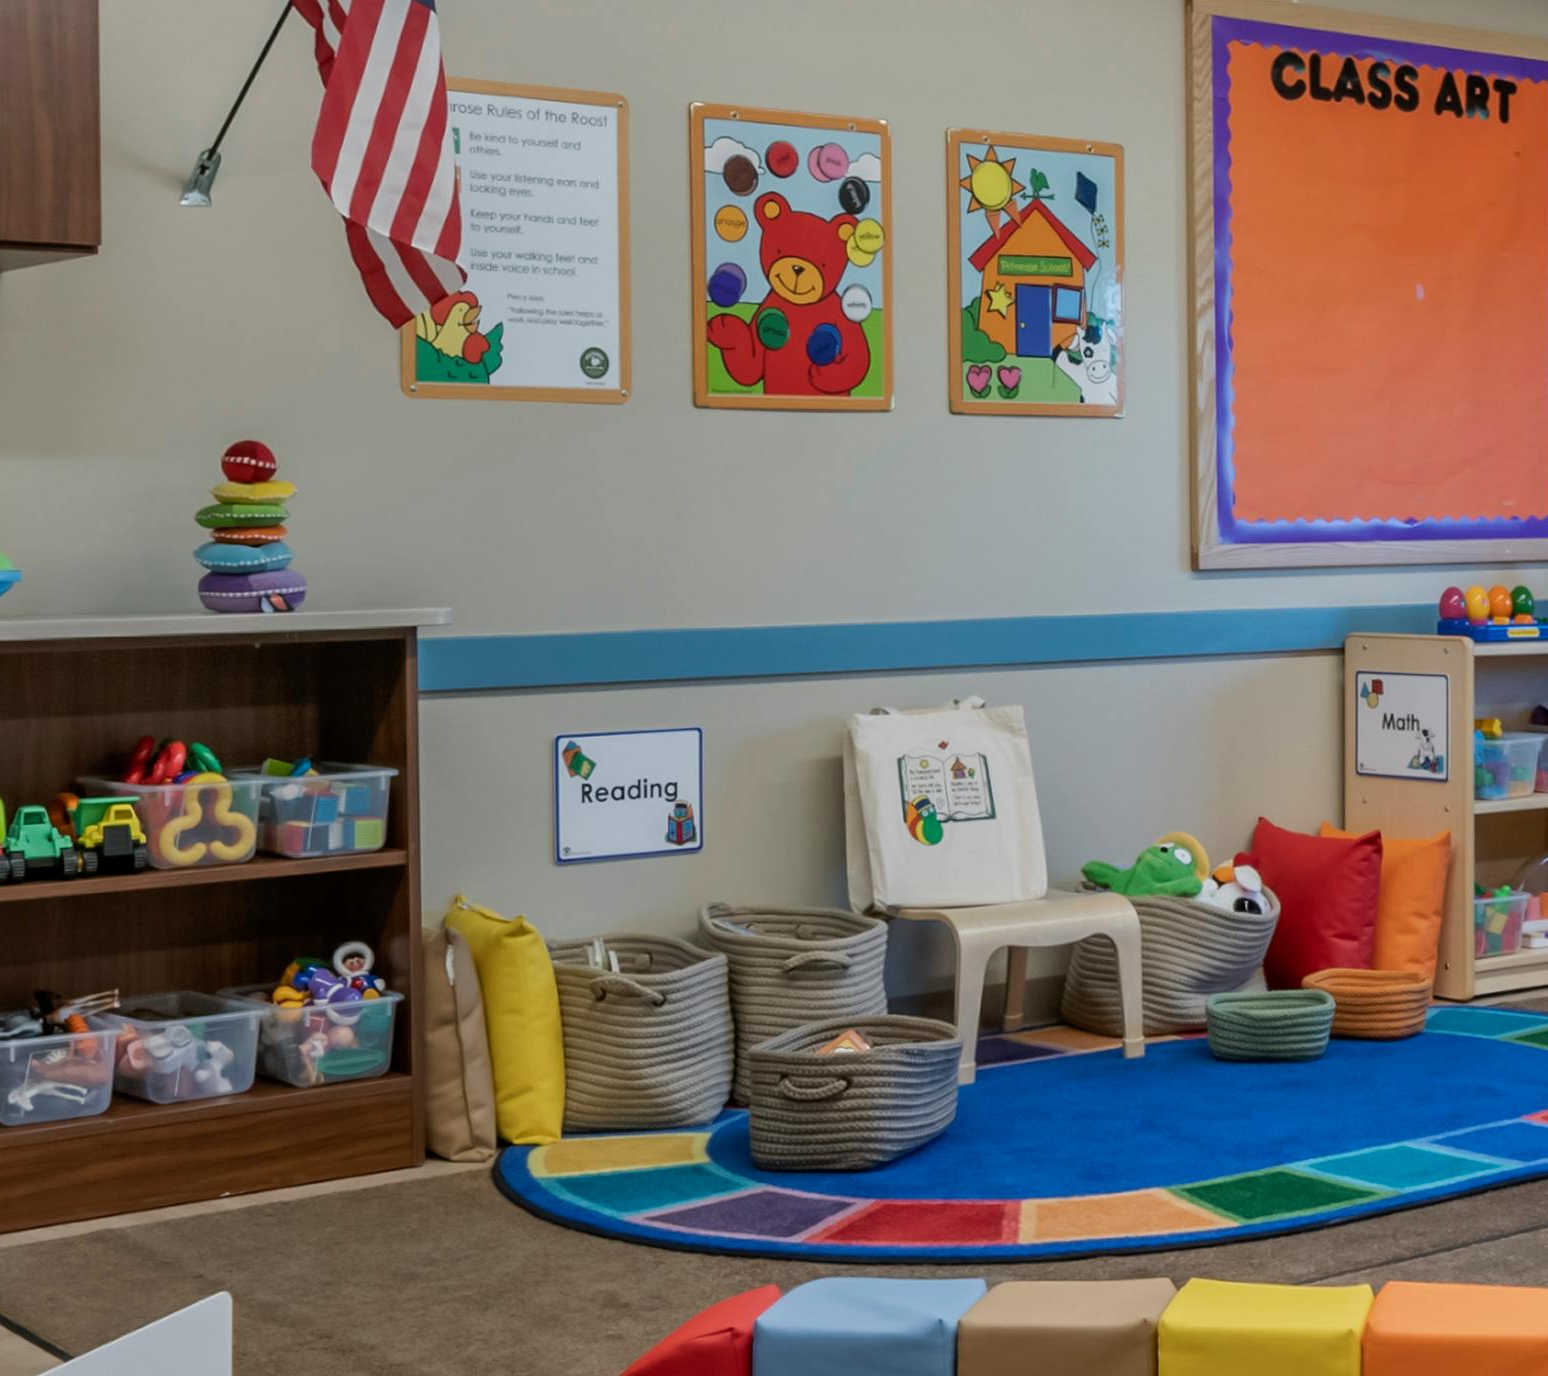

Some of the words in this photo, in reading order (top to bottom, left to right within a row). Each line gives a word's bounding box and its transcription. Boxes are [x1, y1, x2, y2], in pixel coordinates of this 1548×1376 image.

[1271, 50, 1420, 112] CLASS
[1434, 71, 1518, 124] ART
[487, 103, 522, 120] Rules
[526, 107, 541, 120] of
[545, 109, 566, 123] the
[571, 112, 608, 127] Roost
[469, 131, 482, 141] Be
[484, 132, 506, 144] kind
[508, 135, 519, 144] to
[521, 137, 558, 149] yourself
[561, 140, 581, 151] and
[470, 170, 487, 180] Use
[490, 173, 512, 184] your
[515, 173, 553, 188] listening
[556, 177, 577, 187] ears
[580, 179, 599, 190] and
[470, 184, 506, 197] looking
[470, 209, 498, 221] Keep
[499, 212, 521, 223] your
[524, 212, 555, 224] hands
[557, 215, 577, 226] and
[579, 217, 599, 228] feet
[470, 224, 481, 233] to
[470, 248, 488, 258] Use
[490, 251, 512, 262] your
[515, 252, 552, 264] walking
[555, 253, 575, 263] feet
[577, 255, 598, 265] and
[470, 261, 499, 272] inside
[502, 264, 530, 274] voice
[532, 265, 541, 274] in
[1382, 712, 1420, 731] Math
[581, 779, 678, 803] Reading
